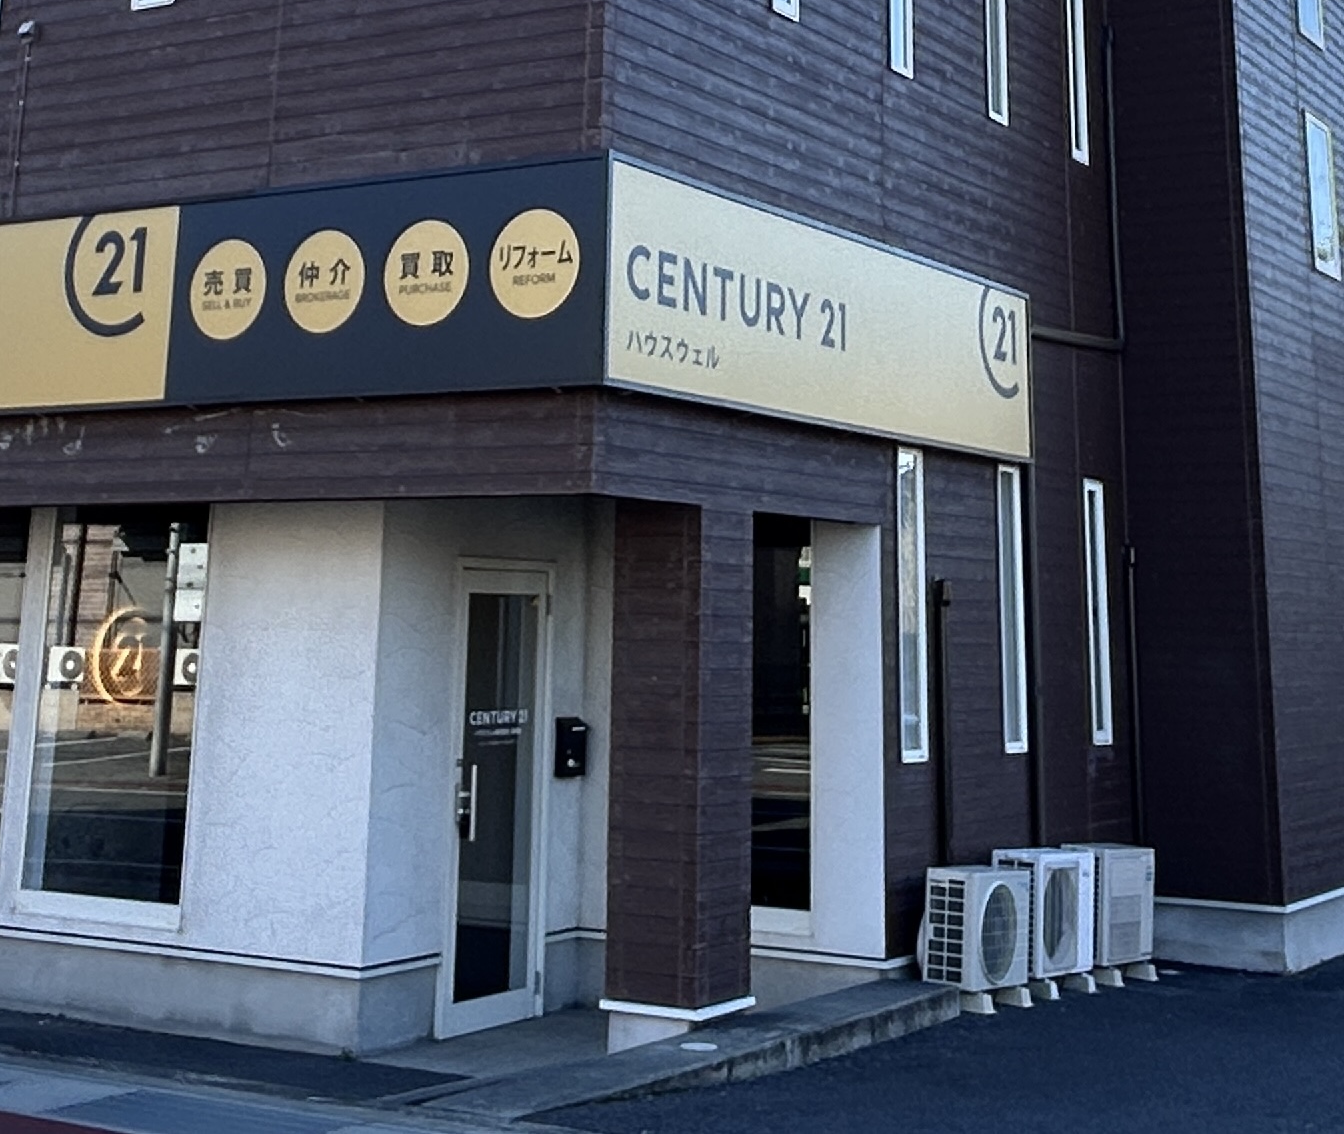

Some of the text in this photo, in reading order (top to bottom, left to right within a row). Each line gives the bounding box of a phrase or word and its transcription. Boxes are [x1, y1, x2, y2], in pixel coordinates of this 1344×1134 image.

[399, 250, 454, 279] 買取
[499, 240, 574, 271] リフォーム
[203, 267, 252, 296] 売買
[298, 258, 351, 289] 仲介
[398, 281, 452, 295] PURCHASE
[512, 272, 556, 286] REFORM
[626, 244, 846, 352] CENTURY 21
[626, 329, 720, 370] ハウスウェル
[469, 709, 518, 726] CENTURY
